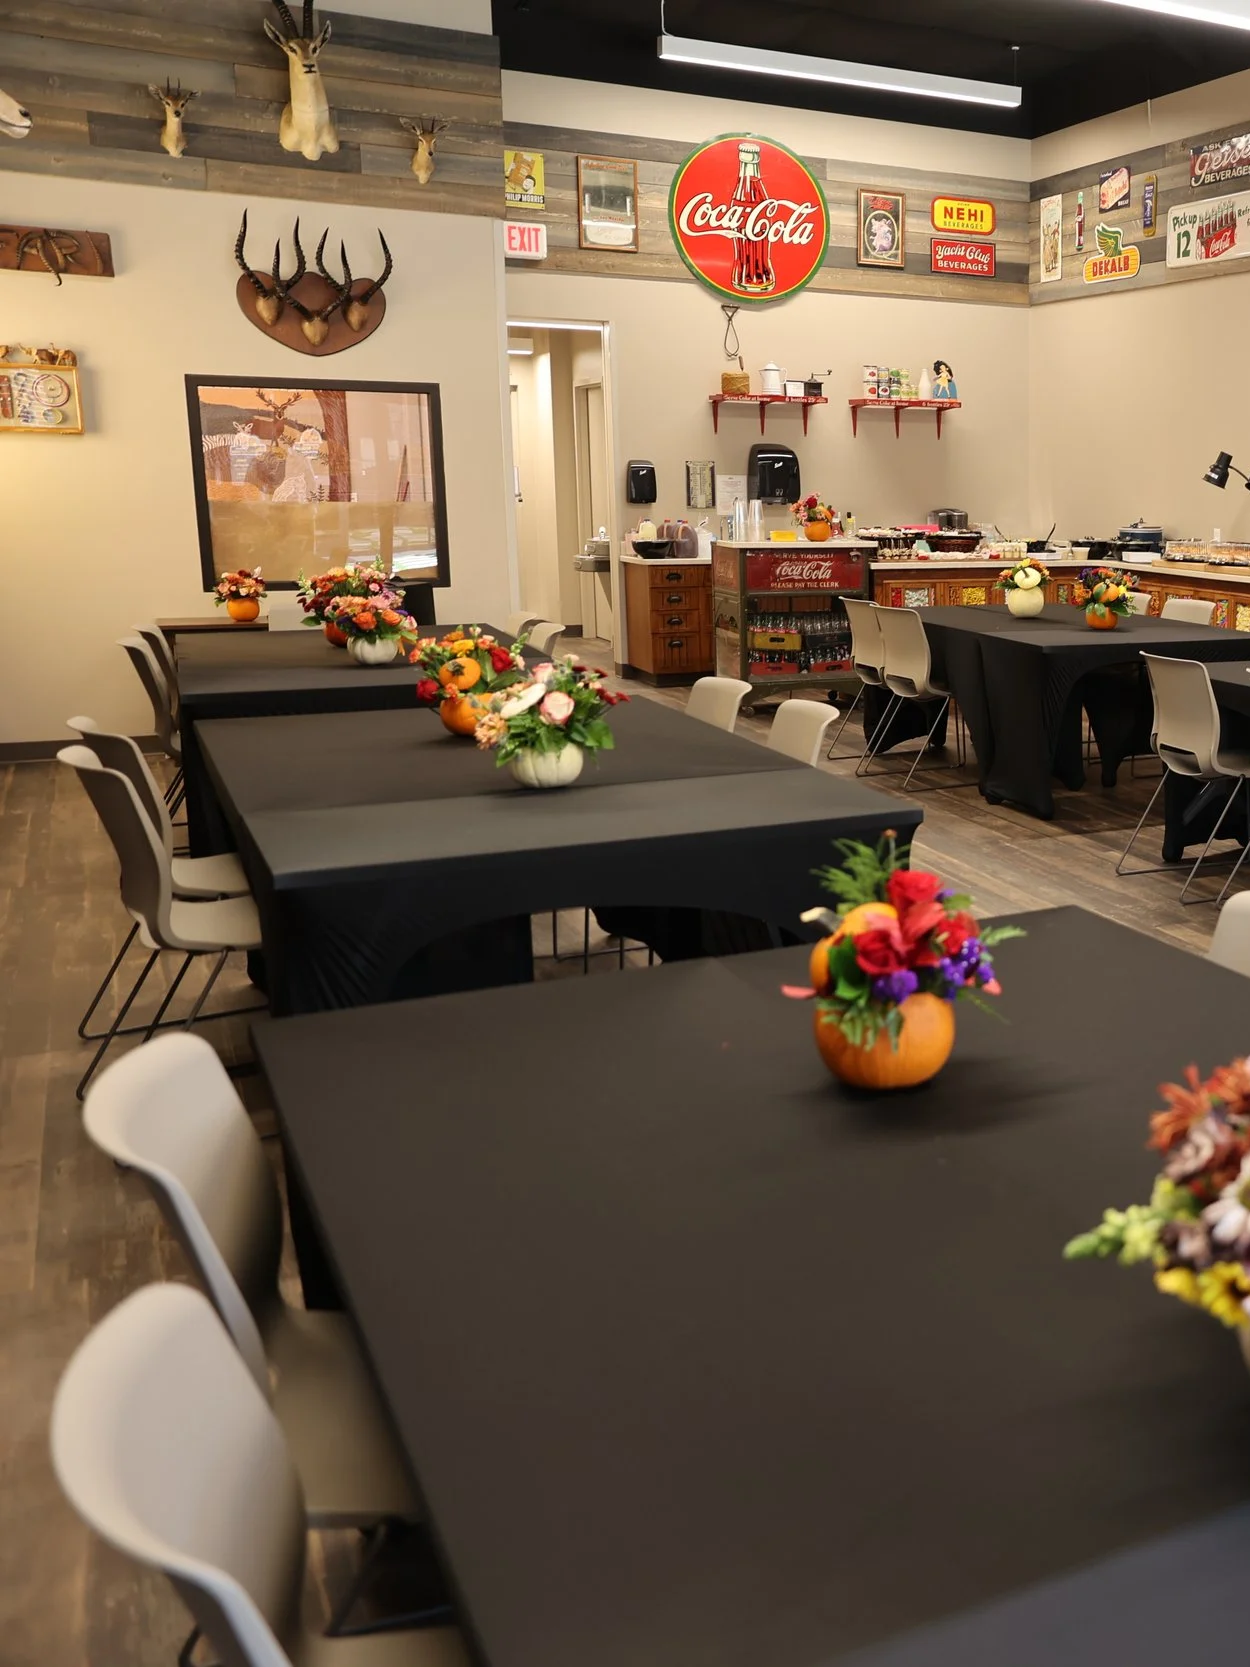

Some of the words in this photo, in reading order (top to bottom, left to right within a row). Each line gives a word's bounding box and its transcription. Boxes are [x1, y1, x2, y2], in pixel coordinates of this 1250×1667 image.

[1202, 142, 1221, 152] ASK
[522, 194, 543, 203] MORRIS
[679, 192, 819, 245] Coca-Cola
[943, 206, 984, 223] NEHI
[1172, 213, 1188, 232] Pick
[1188, 214, 1198, 228] up
[943, 221, 984, 230] BEVERAGES
[507, 225, 541, 252] EXIT
[1176, 230, 1191, 258] 12
[936, 245, 966, 259] Yacht
[966, 246, 990, 264] Club
[938, 259, 989, 272] BEVERAGES
[1092, 255, 1130, 277] DEKALB
[776, 560, 835, 580] Coca-Cola
